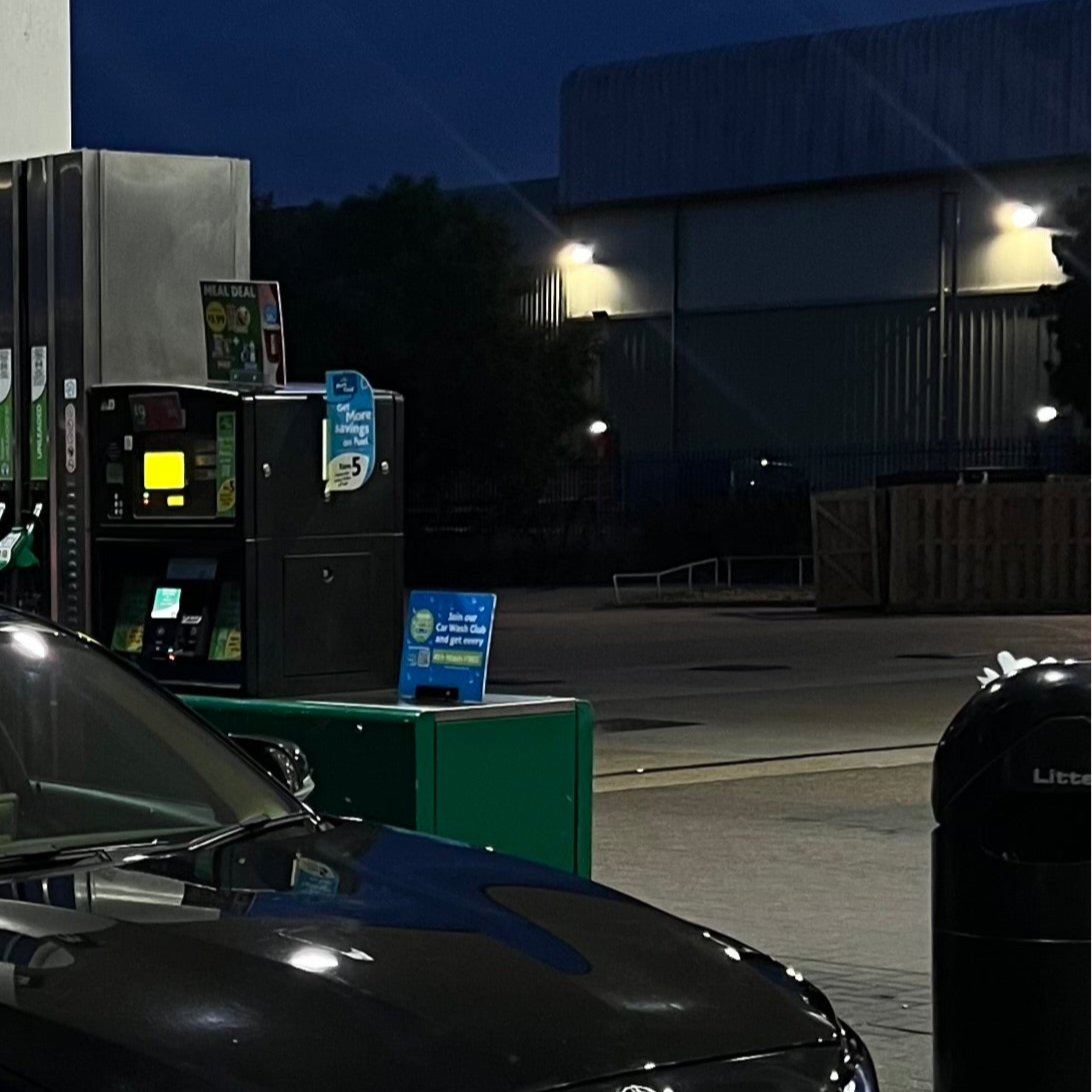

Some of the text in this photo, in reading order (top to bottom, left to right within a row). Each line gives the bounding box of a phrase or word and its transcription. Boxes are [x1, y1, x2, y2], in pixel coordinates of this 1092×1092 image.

[204, 284, 256, 299] MEAL DEAL
[345, 410, 372, 423] More
[335, 424, 369, 438] savings
[342, 439, 353, 447] on
[352, 456, 361, 477] 5
[448, 612, 478, 622] Join our
[435, 622, 487, 635] Car Wash Club
[435, 635, 484, 648] and get every
